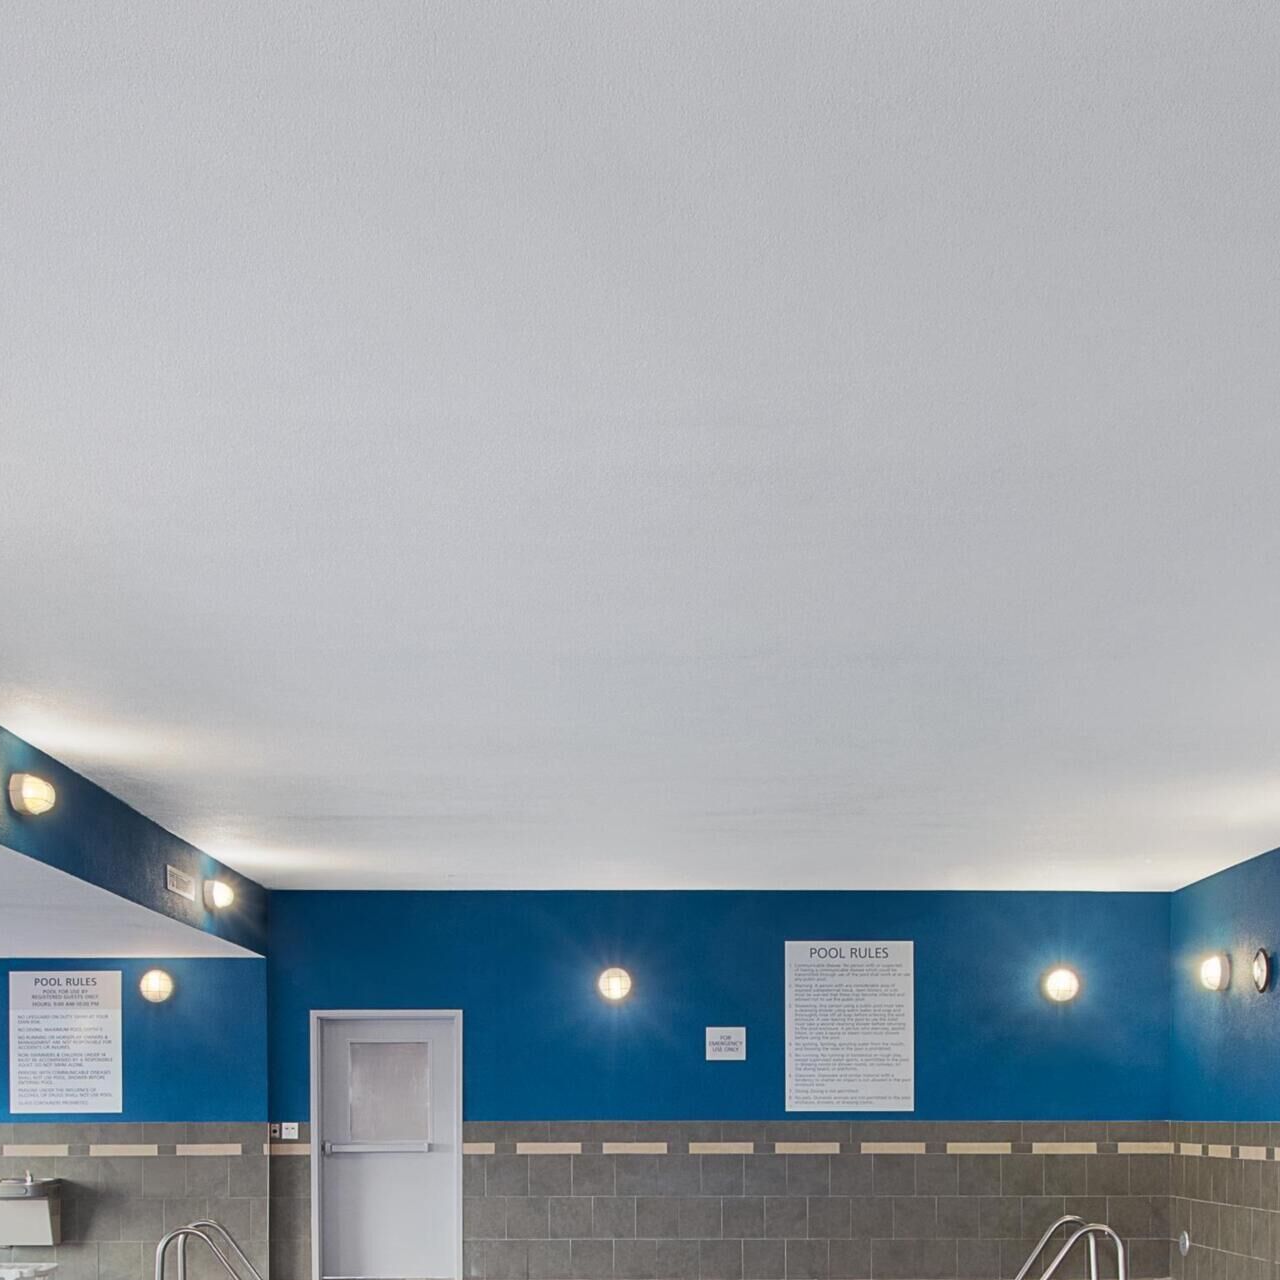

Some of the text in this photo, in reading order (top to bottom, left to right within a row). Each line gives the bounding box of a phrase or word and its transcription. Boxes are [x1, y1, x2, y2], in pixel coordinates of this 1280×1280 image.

[809, 947, 889, 959] POOL RULES
[34, 977, 97, 987] POOL RULES
